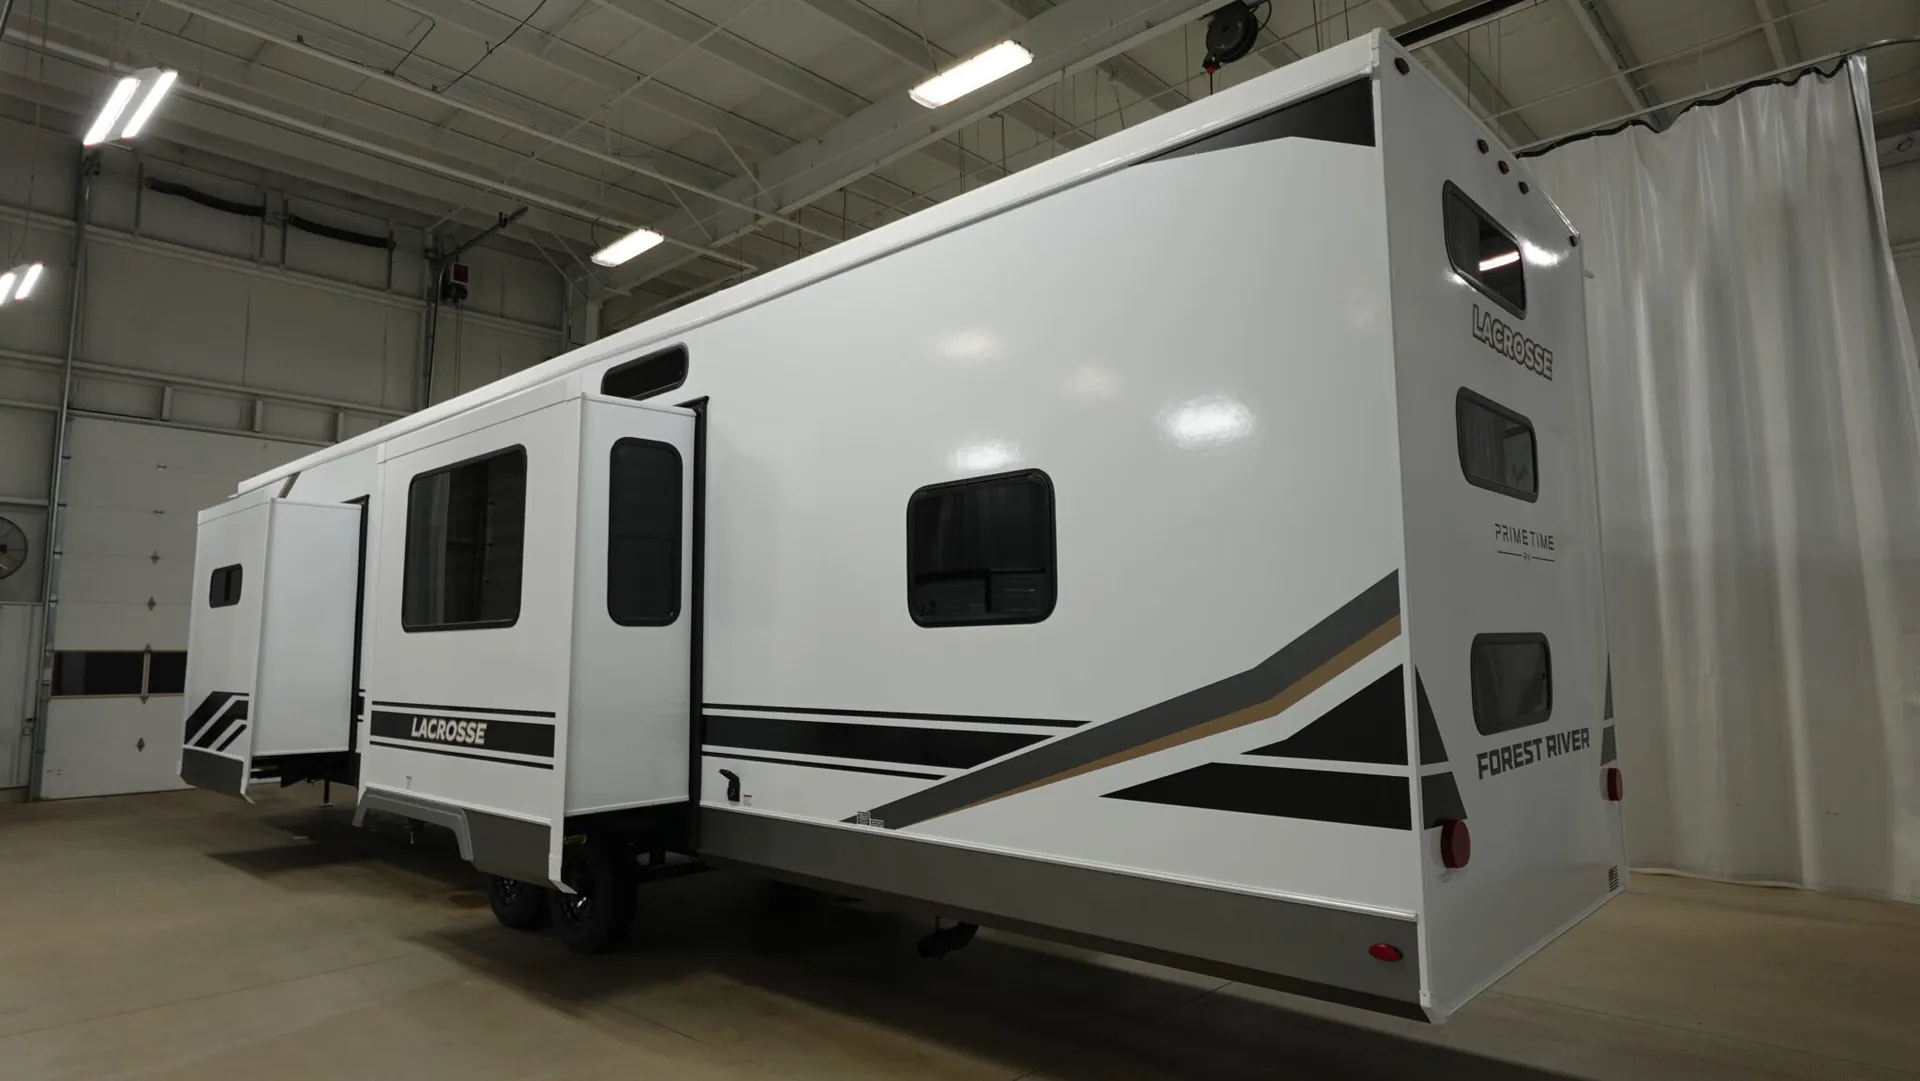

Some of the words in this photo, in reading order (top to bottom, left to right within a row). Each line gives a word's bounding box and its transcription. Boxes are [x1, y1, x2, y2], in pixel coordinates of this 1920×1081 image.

[1472, 303, 1553, 381] LACROSSE
[411, 717, 488, 745] LACROSSE
[1476, 738, 1543, 780] FOREST
[1545, 727, 1590, 758] RIVER
